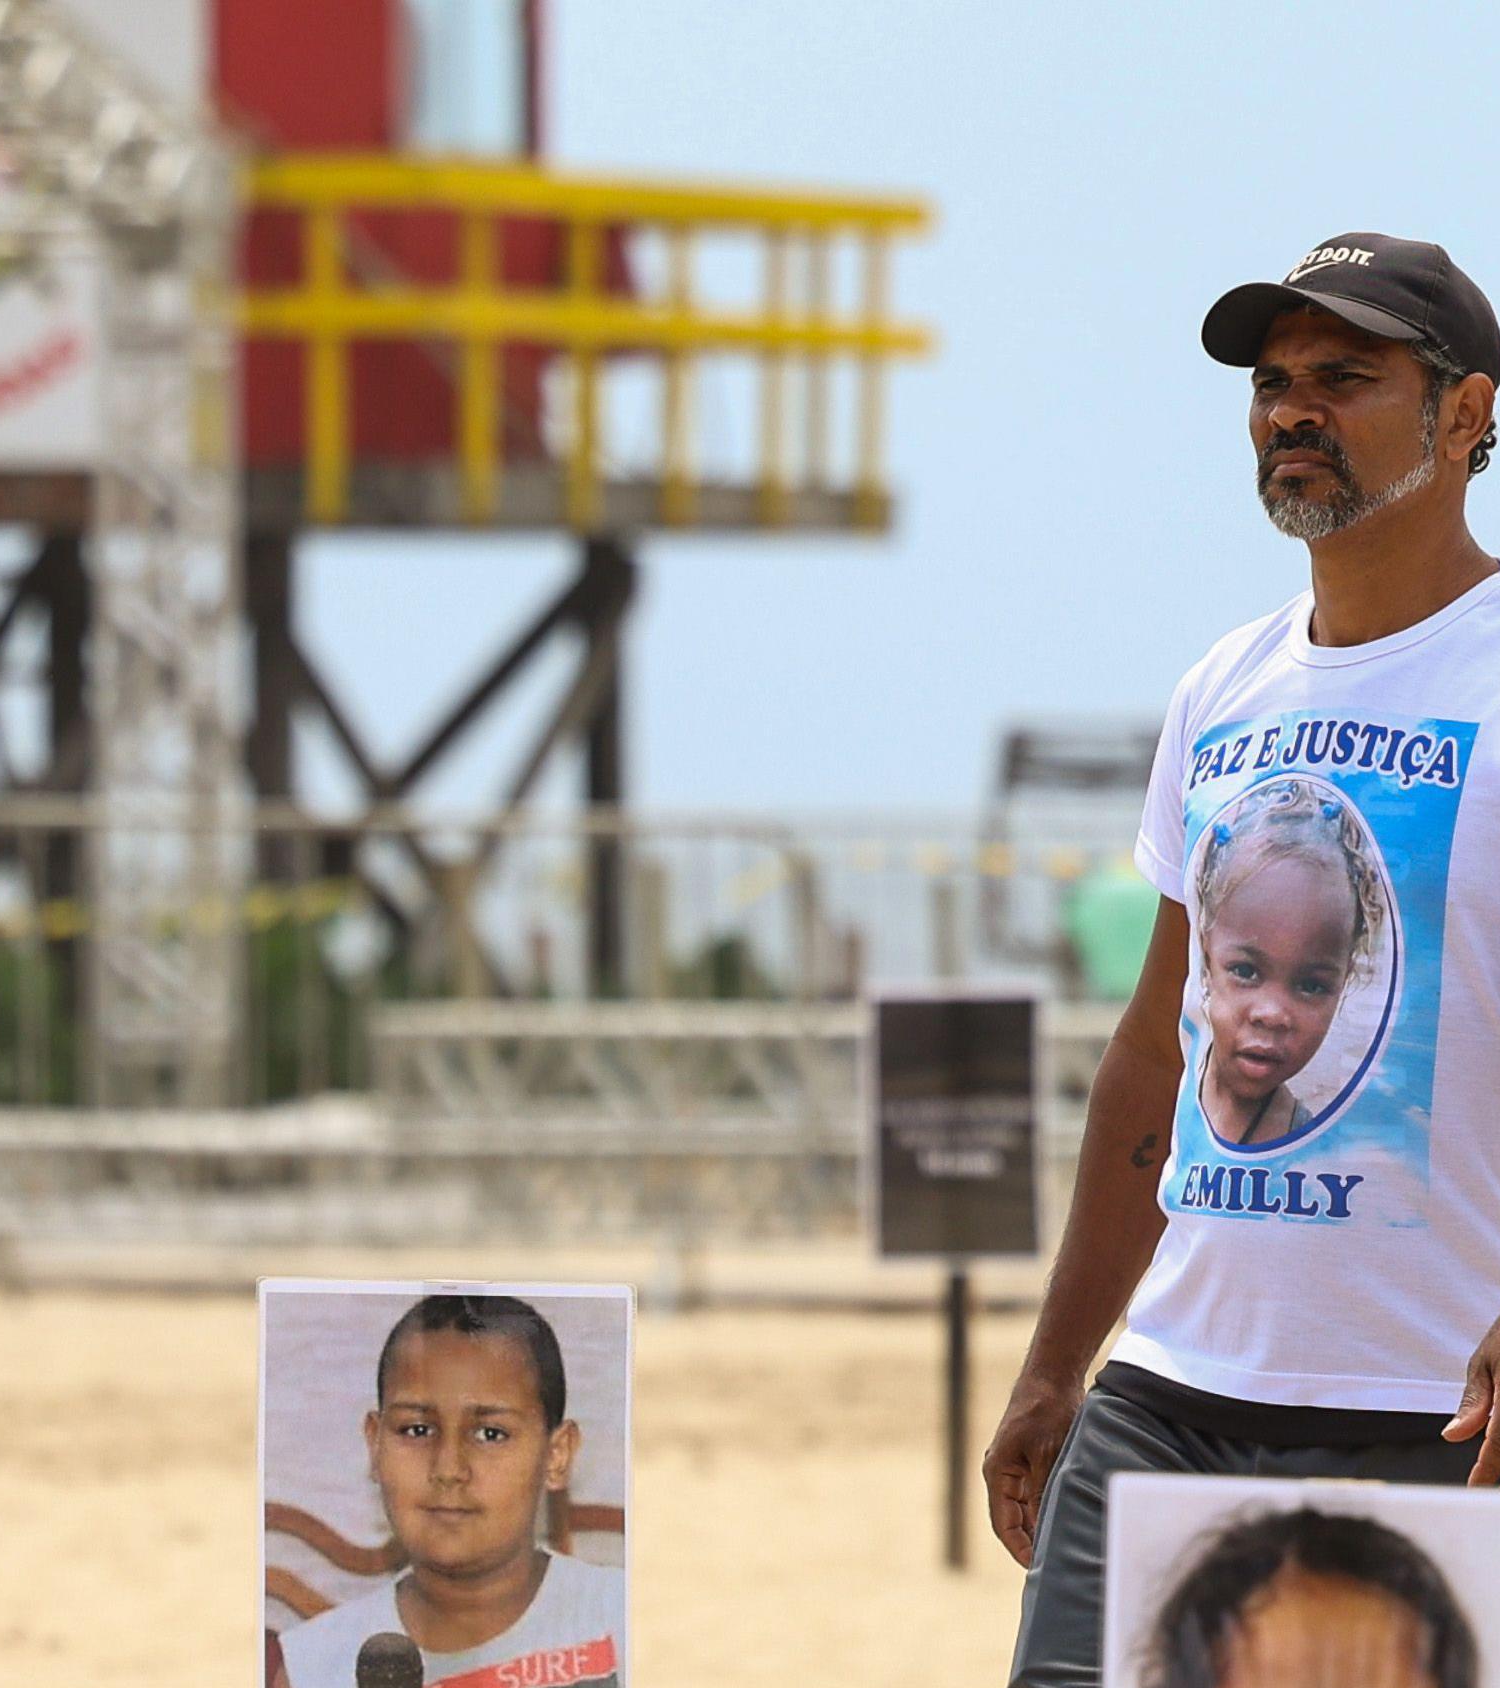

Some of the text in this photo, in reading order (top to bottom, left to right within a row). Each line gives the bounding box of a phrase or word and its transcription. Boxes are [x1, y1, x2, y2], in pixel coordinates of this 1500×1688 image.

[1189, 720, 1459, 791] PAZ E JUSTIÇA
[1181, 1164, 1365, 1219] EMILLY
